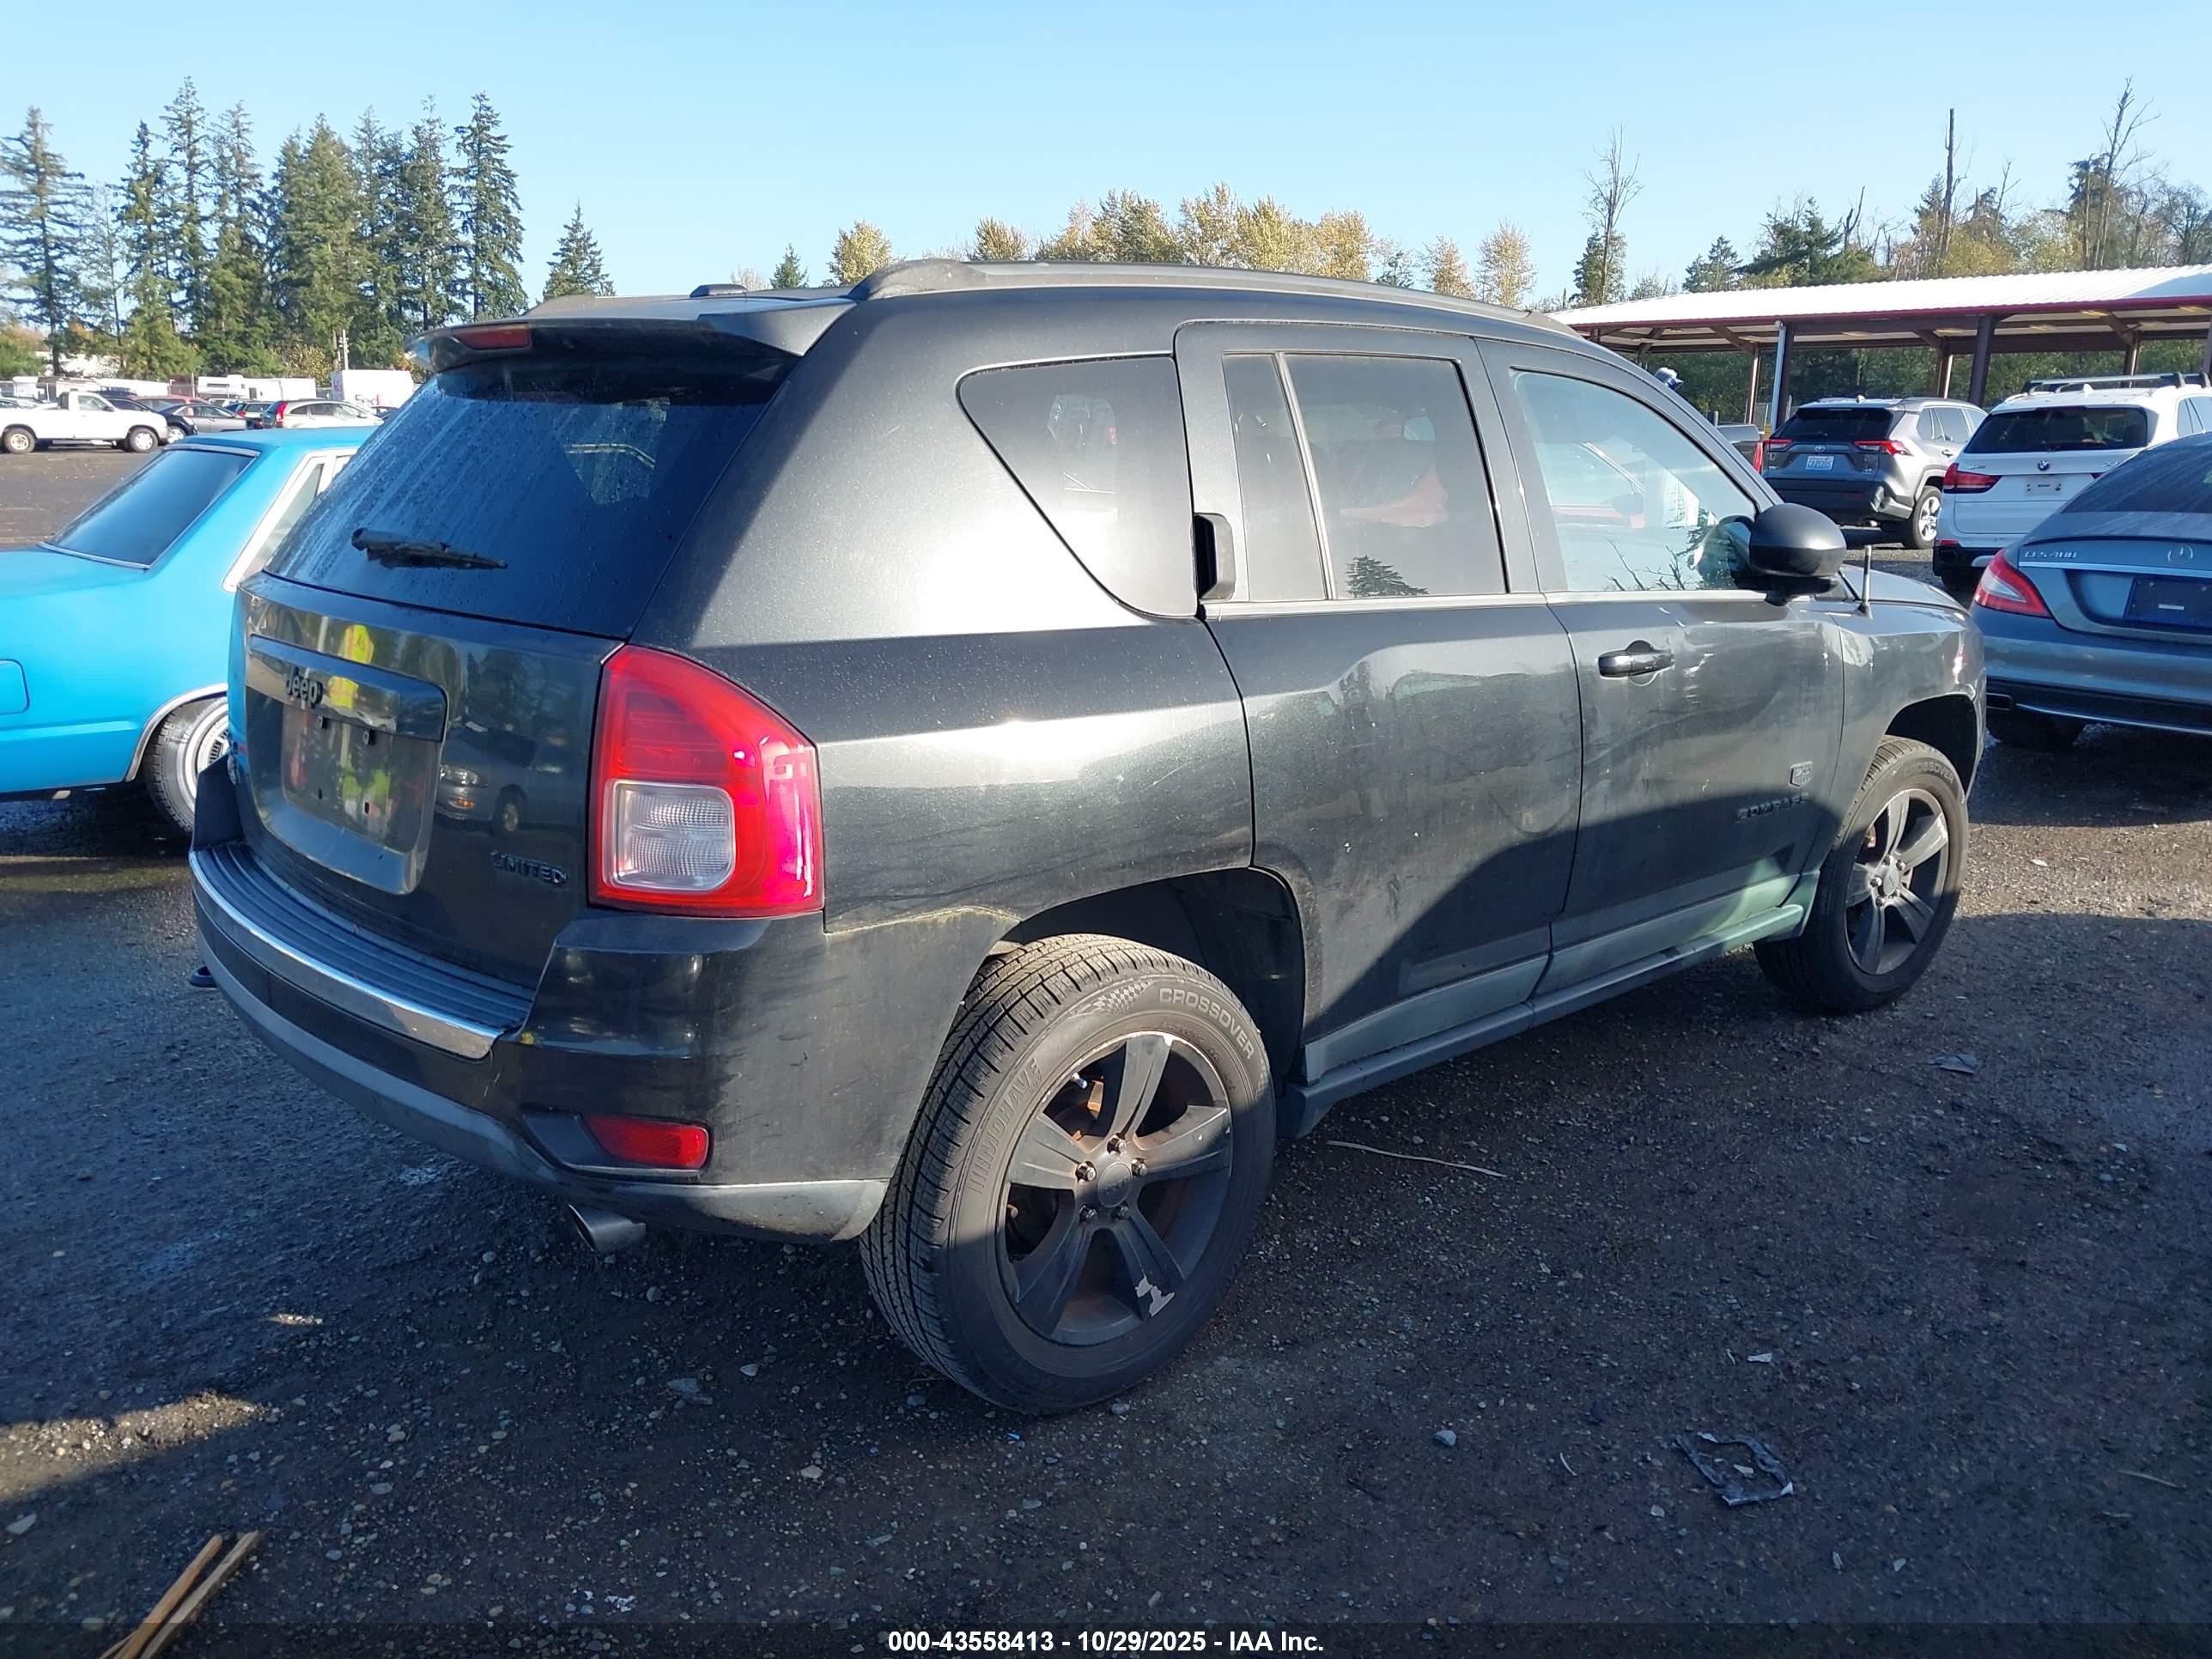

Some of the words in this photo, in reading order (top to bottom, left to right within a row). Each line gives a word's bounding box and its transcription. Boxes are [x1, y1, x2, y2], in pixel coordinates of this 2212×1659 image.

[286, 666, 321, 708] Jeep
[490, 850, 568, 885] LIMITED
[1159, 988, 1255, 1060] CROSSOVER
[981, 1057, 1043, 1161] MOHAVE
